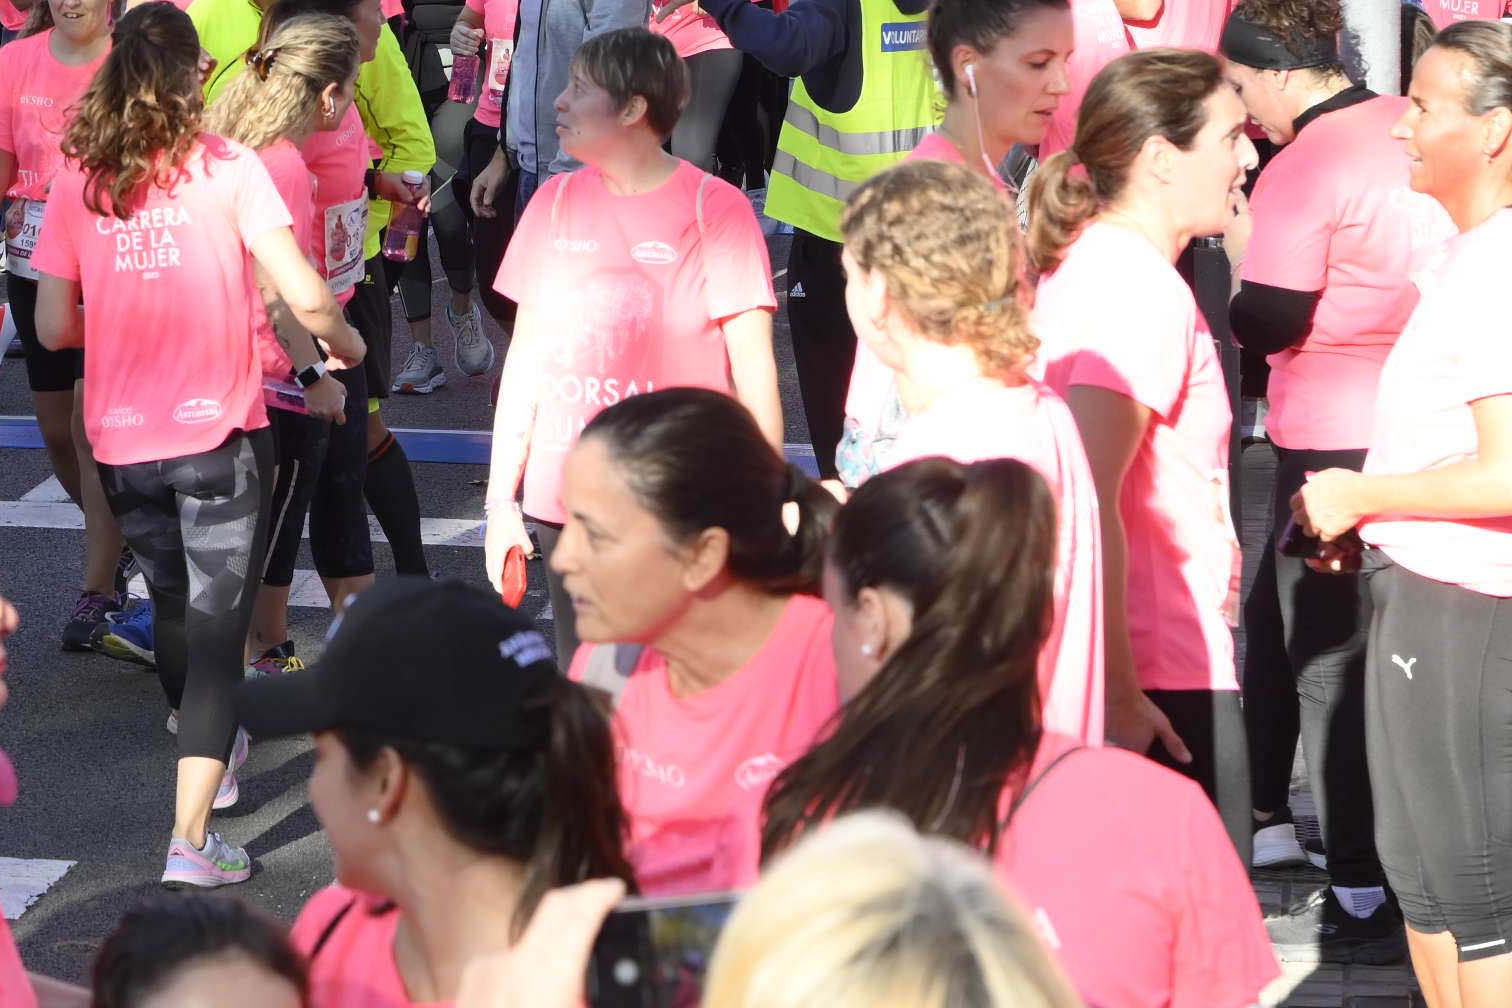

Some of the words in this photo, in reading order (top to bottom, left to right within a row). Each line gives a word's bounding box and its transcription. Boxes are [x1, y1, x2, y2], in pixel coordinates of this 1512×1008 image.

[22, 223, 43, 237] 01
[96, 206, 194, 235] CARRERA
[116, 231, 143, 254] DE
[150, 228, 176, 248] LA
[115, 248, 180, 273] MUJER
